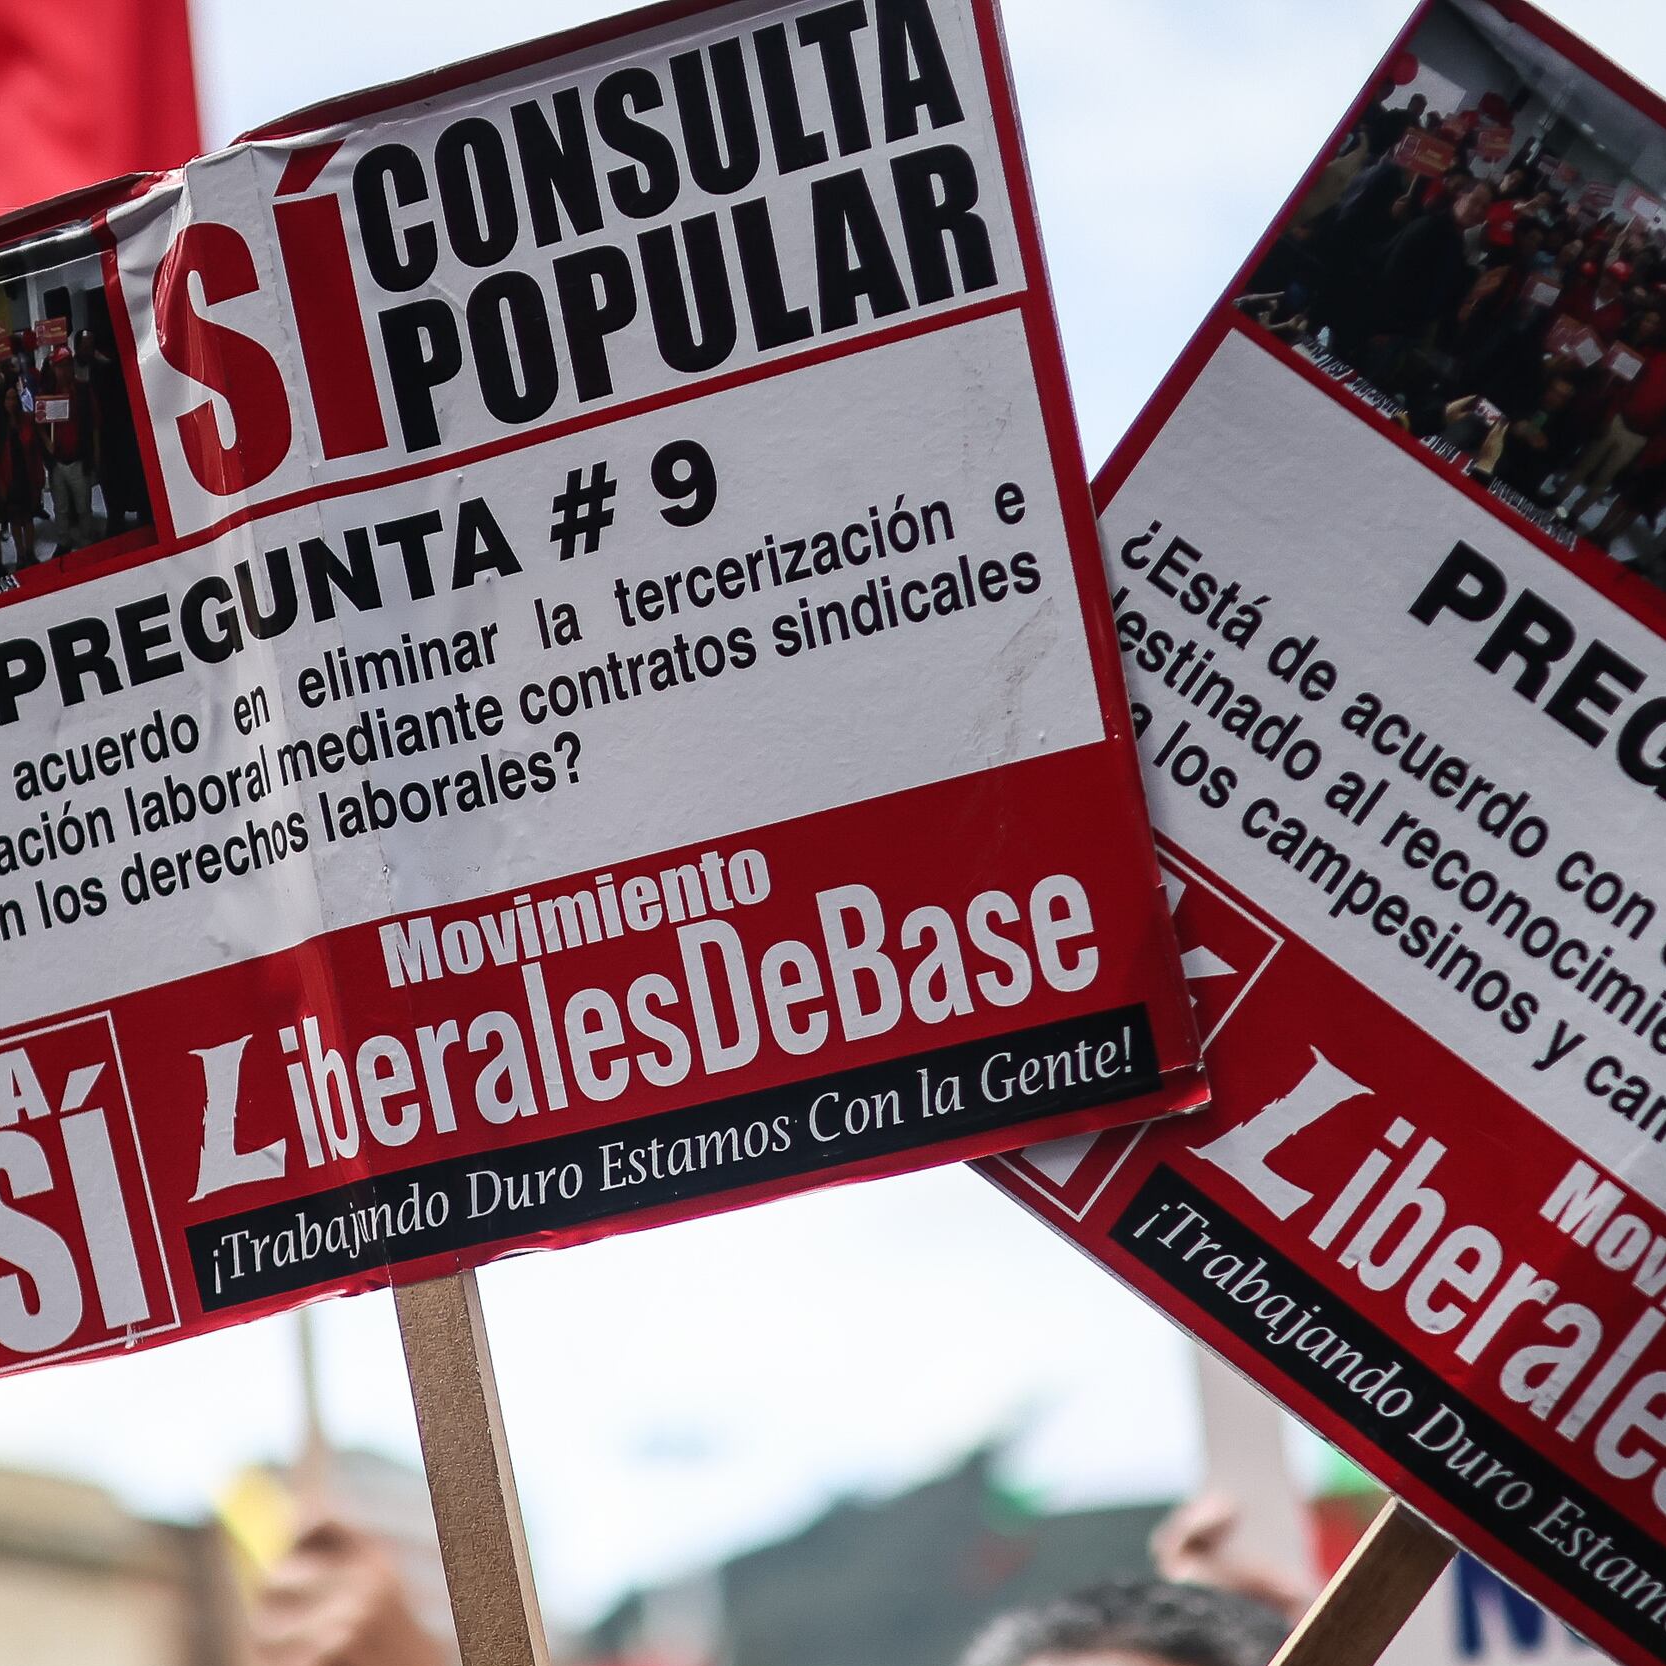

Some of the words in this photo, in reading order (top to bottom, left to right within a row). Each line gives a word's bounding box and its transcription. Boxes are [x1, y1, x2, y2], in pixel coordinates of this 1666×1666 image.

[352, 0, 966, 293] CONSULTA
[153, 148, 387, 497] SÍ
[379, 145, 995, 455] POPULAR
[13, 709, 200, 802] acuerdo
[233, 685, 271, 736] en
[298, 622, 499, 709] eliminar
[533, 597, 583, 650] la
[613, 493, 955, 627] tercerización
[994, 482, 1026, 525] e
[549, 460, 618, 562] #
[650, 439, 718, 528] 9
[34, 877, 108, 930] los
[120, 812, 309, 906] derechos
[318, 731, 582, 843] laborales?
[124, 744, 272, 837] laboral
[276, 692, 504, 787] mediante
[519, 627, 757, 725] contratos
[772, 551, 1041, 657] sindicales
[1120, 519, 1272, 651] ¿Está
[1267, 635, 1337, 702] de
[1340, 692, 1549, 859] acuerdo
[1556, 850, 1656, 941] con
[1324, 771, 1391, 827] al
[187, 874, 1099, 1203] LiberalesDeBase
[378, 846, 772, 990] Movimiento
[1152, 719, 1238, 809] los
[1241, 797, 1539, 1035] campesinos
[1531, 1019, 1586, 1072] y
[465, 1163, 583, 1220] Duro
[598, 1115, 791, 1192] Estamos
[808, 1089, 905, 1143] Con
[916, 1067, 966, 1119] la
[980, 1025, 1132, 1103] Gente!
[1132, 1202, 1414, 1418] ¡Trabajando
[1407, 1403, 1533, 1510] Duro
